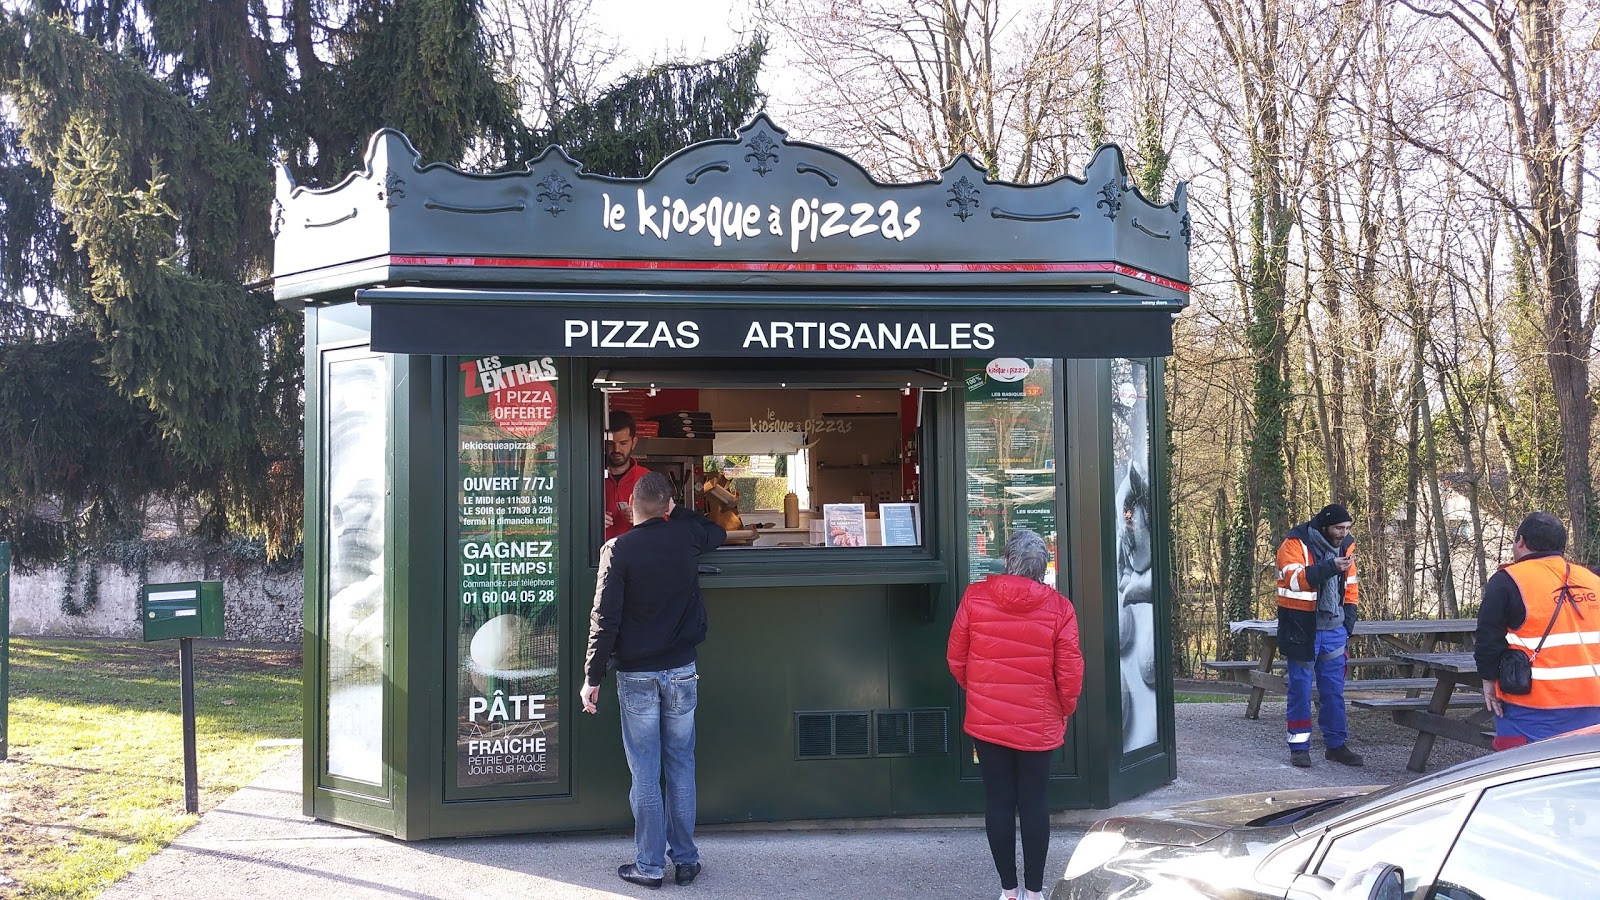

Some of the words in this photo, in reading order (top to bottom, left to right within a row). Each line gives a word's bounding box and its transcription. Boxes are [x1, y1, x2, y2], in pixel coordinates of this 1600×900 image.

[602, 193, 626, 231] le
[637, 188, 762, 247] kiosque
[767, 205, 783, 236] à
[790, 198, 922, 253] pizzas
[564, 320, 700, 349] PIZZAS
[742, 321, 996, 350] ARTISANALES
[476, 355, 502, 373] LES
[494, 391, 501, 403] 1
[506, 390, 552, 403] PIZZA
[494, 406, 552, 419] OFFERTE
[767, 408, 776, 420] le
[749, 417, 794, 433] kiosque
[804, 419, 853, 439] pizzas
[462, 441, 536, 451] lekiosqueapizzas
[463, 477, 519, 491] OUVERT
[523, 476, 554, 491] 7/7J
[463, 496, 473, 505] LE
[475, 496, 494, 504] MIDI
[495, 496, 505, 504] de
[507, 496, 530, 504] 11h30
[532, 496, 537, 504] à
[539, 496, 553, 504] 14h
[463, 507, 473, 515] LE
[475, 507, 494, 515] SOIR
[496, 506, 505, 515] de
[507, 506, 530, 514] 17h30
[532, 506, 537, 514] à
[539, 506, 553, 514] 22h
[463, 517, 487, 525] fermé
[488, 517, 495, 525] le
[497, 517, 534, 525] dimanche
[535, 516, 553, 524] midi
[463, 541, 553, 559] GAGNEZ
[463, 563, 487, 576] DU
[463, 580, 506, 588] Commandez
[521, 579, 555, 587] téléphone
[463, 592, 477, 604] 01
[482, 591, 498, 603] 60
[501, 591, 516, 603] 04
[520, 590, 536, 603] 05
[539, 590, 554, 602] 28
[469, 690, 546, 721] PÂTE
[490, 721, 546, 738] PIZZA
[469, 735, 547, 755] FRAÎCHE
[468, 755, 503, 766] PÉTRIE
[504, 753, 546, 764] CHAQUE
[468, 765, 493, 775] JOUR
[495, 765, 514, 774] SUR
[516, 763, 546, 773] PLACE
